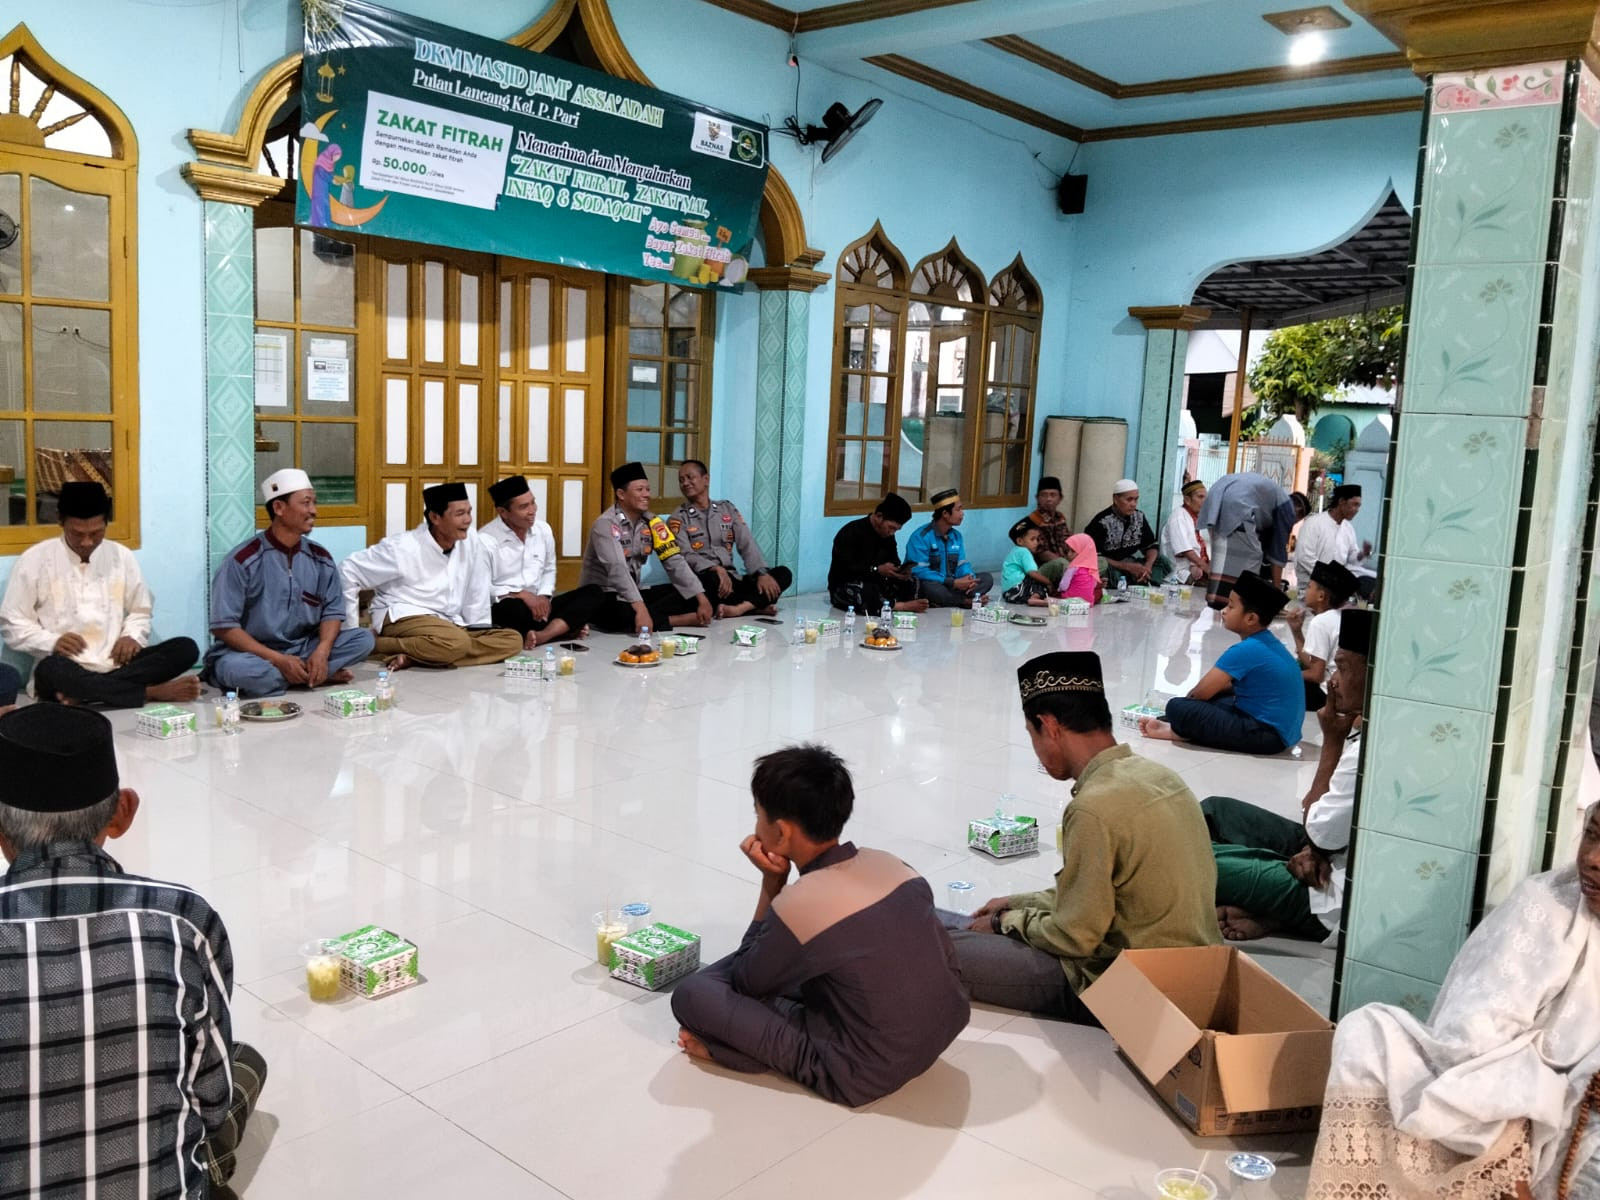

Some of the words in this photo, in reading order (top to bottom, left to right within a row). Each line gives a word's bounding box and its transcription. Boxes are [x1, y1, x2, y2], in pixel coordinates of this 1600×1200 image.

[414, 37, 462, 72] DKM
[461, 50, 529, 89] MASJID
[412, 68, 453, 93] Pulau
[455, 80, 511, 112] Lancang
[512, 95, 536, 115] Kel.
[538, 102, 550, 119] P.
[553, 106, 581, 126] Pari
[377, 109, 437, 137] ZAKAT
[441, 124, 504, 152] FITRAH
[700, 139, 724, 152] BAZNAS
[383, 156, 427, 175] 50.000
[516, 130, 587, 166] Menerima
[586, 149, 614, 173] dan
[612, 154, 691, 191] Menyalurkan
[505, 176, 555, 208] INFAQ
[557, 188, 570, 207] &
[633, 184, 682, 211] ZAKAT
[648, 216, 670, 235] Ayo
[645, 234, 675, 253] Bayar
[675, 239, 704, 258] Zakat
